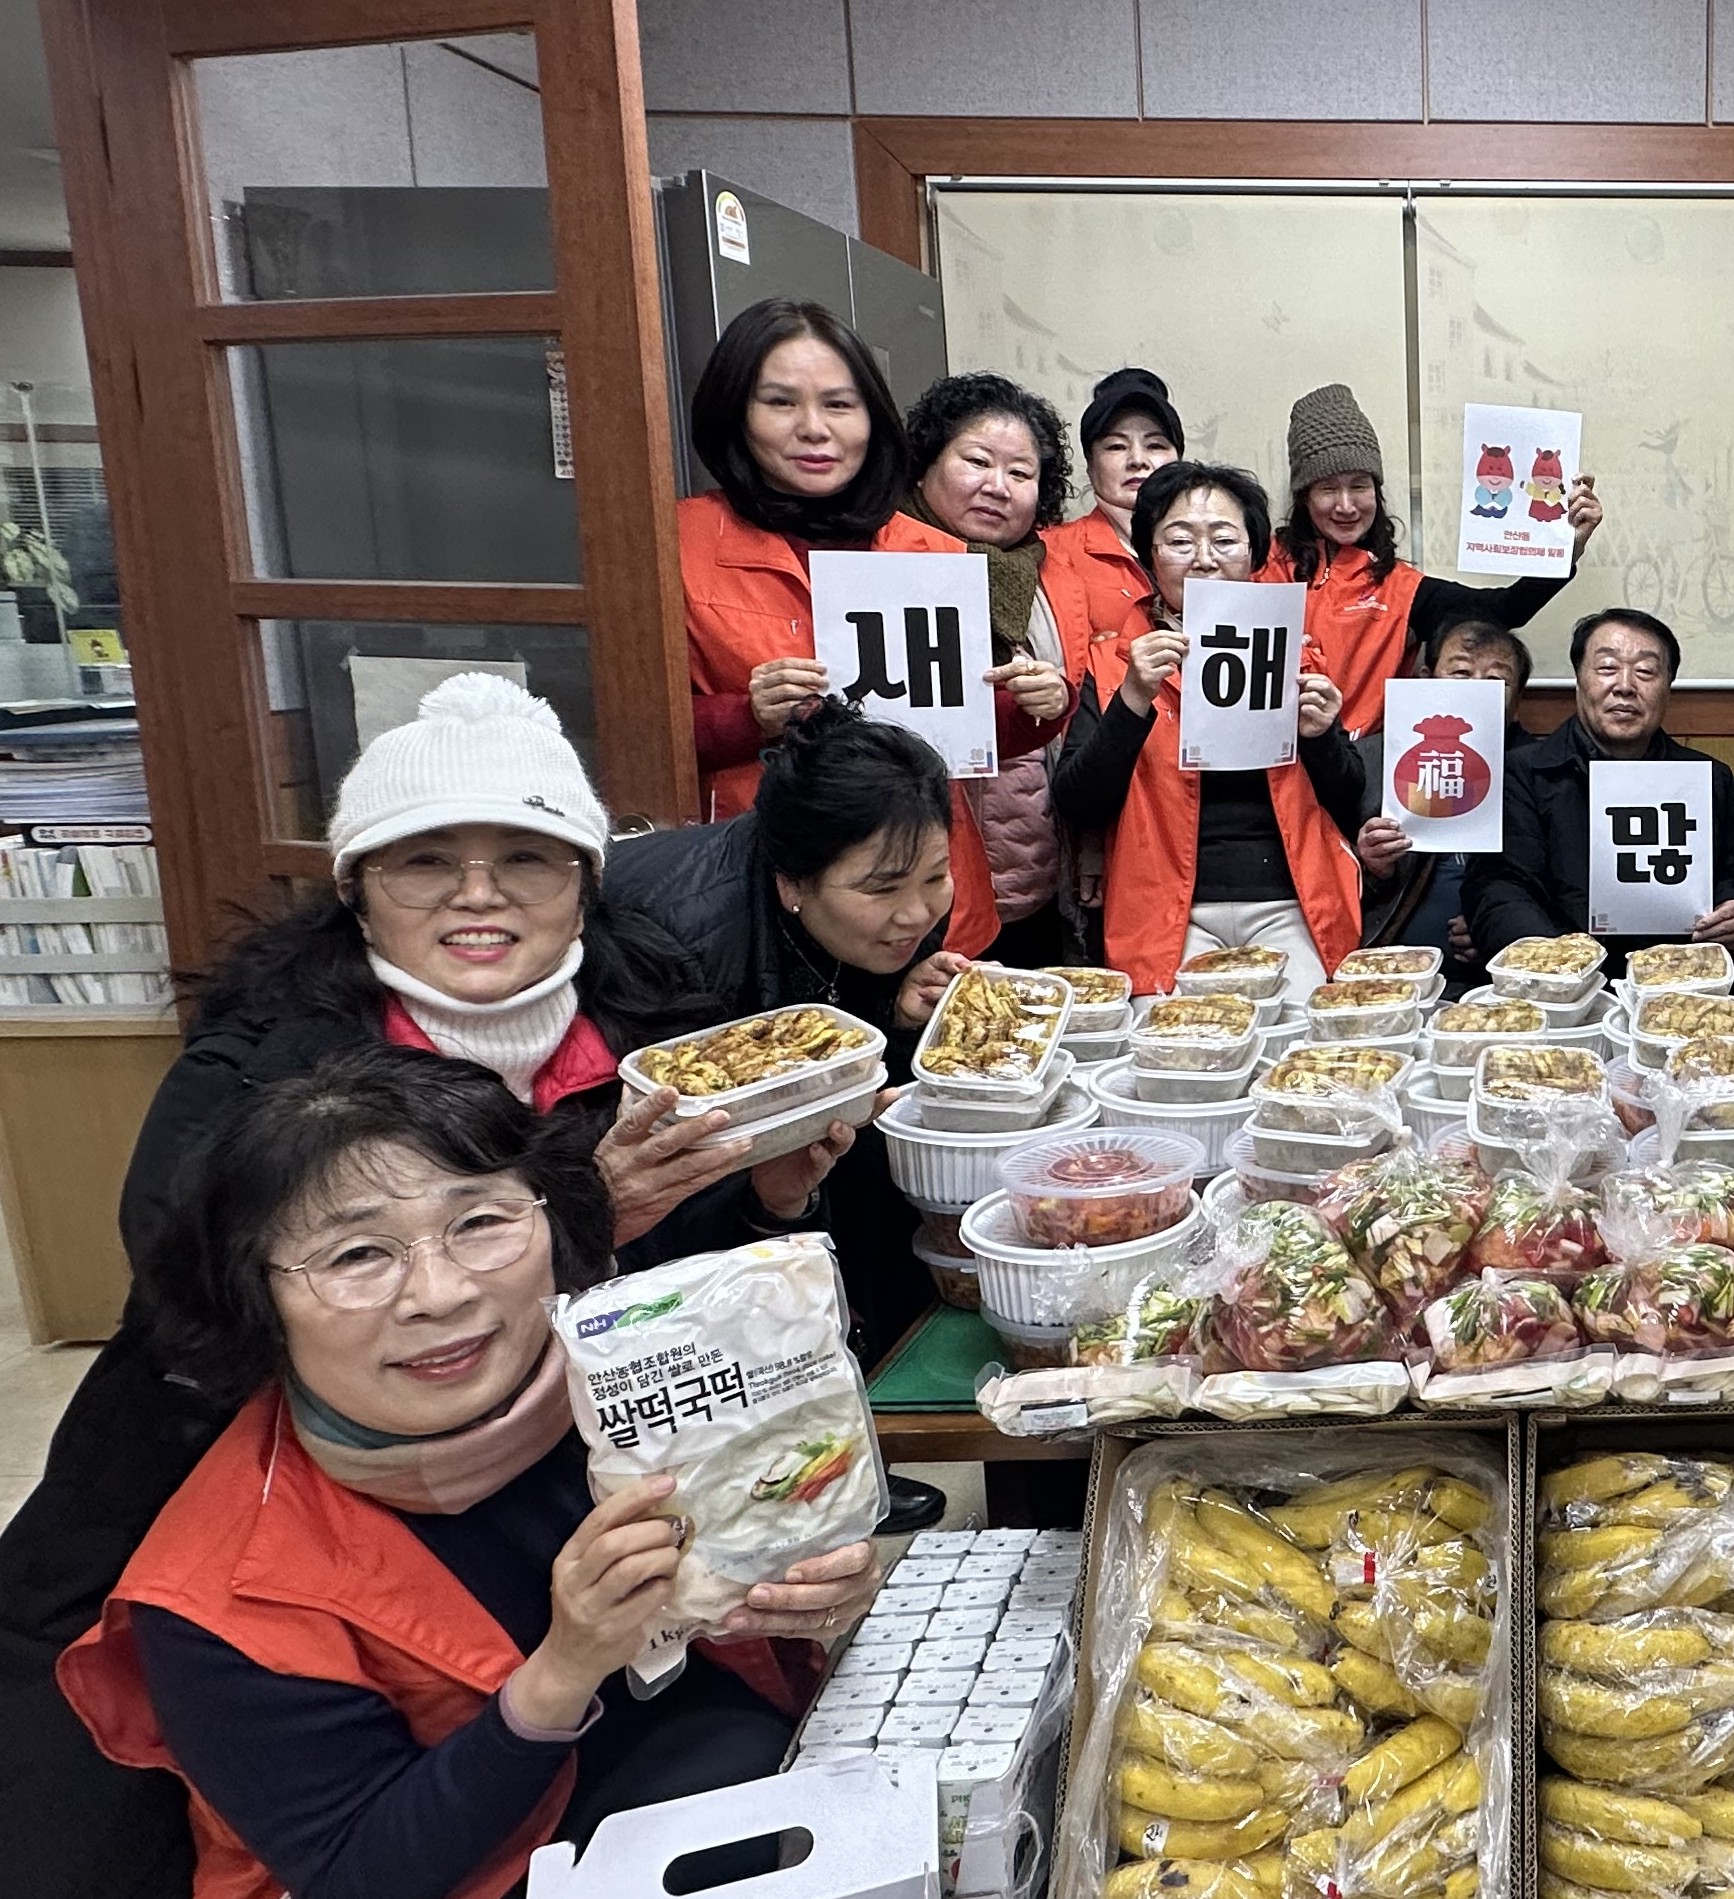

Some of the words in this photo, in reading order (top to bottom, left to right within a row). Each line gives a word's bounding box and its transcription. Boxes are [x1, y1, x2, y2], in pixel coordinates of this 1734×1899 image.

[842, 606, 965, 708] 새
[1200, 624, 1288, 711] 해
[1416, 750, 1465, 799] 福
[1604, 801, 1697, 885] 많
[580, 1318, 607, 1334] NH
[587, 1341, 697, 1386] 안산농협조합원의
[592, 1379, 634, 1401] 정성이
[636, 1368, 665, 1390] 담긴
[667, 1360, 696, 1378] 쌀로
[596, 1361, 749, 1449] 쌀떡국떡
